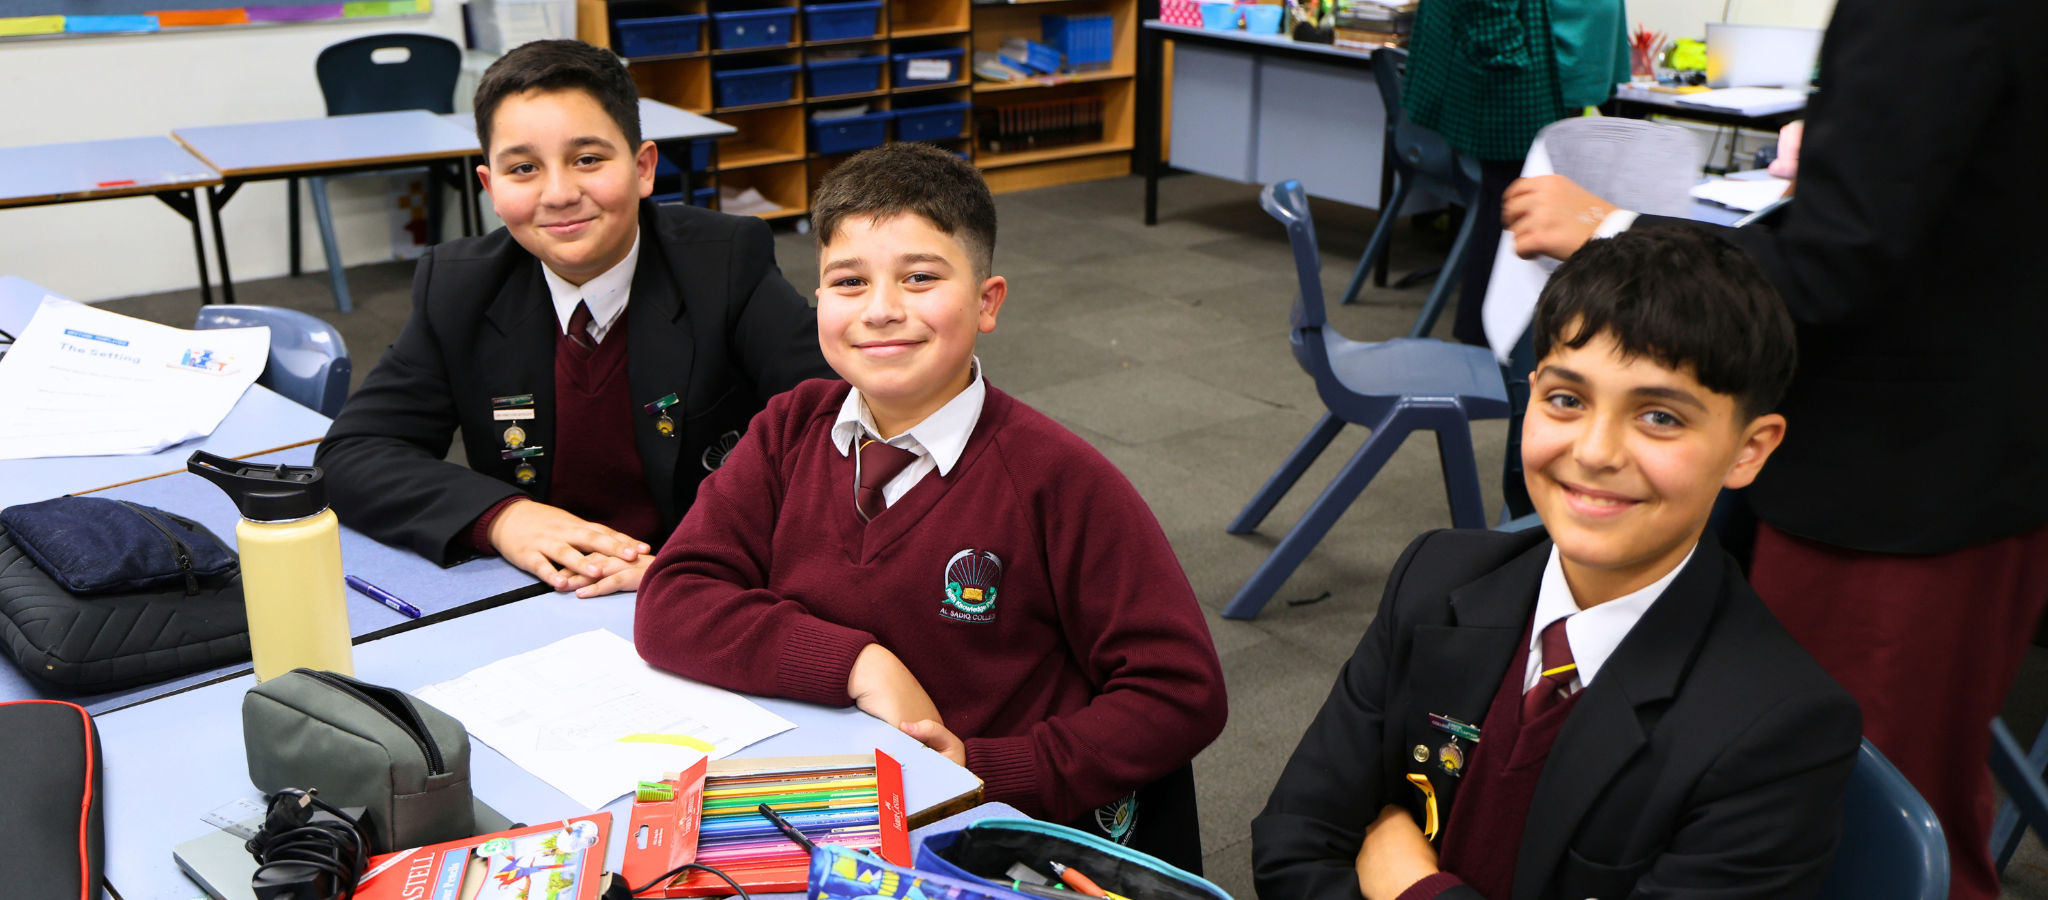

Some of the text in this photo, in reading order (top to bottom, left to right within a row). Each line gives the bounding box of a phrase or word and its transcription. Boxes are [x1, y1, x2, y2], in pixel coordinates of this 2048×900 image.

[60, 342, 141, 365] The Setting
[940, 607, 948, 615] AL
[950, 610, 971, 620] SADIQ
[955, 600, 987, 613] Knowledge
[442, 862, 461, 889] Pencils
